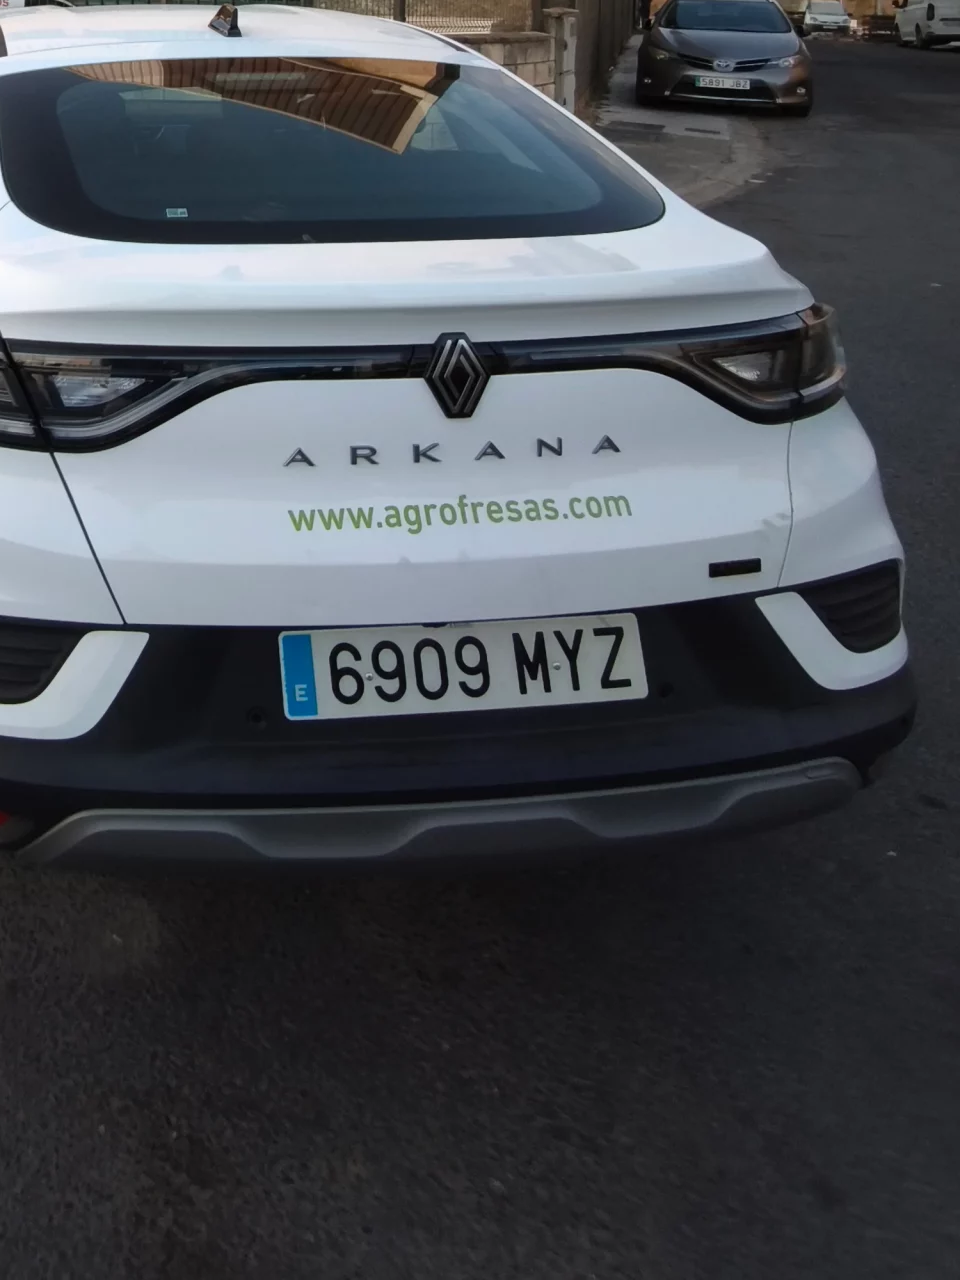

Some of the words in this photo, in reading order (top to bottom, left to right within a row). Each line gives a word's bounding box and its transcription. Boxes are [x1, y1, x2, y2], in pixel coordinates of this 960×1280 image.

[701, 78, 725, 87] 5891
[283, 434, 622, 468] ARKANA
[287, 494, 633, 535] www.agrofresas.com
[328, 635, 491, 705] 6909
[512, 626, 632, 695] MYZ
[295, 684, 309, 702] E
